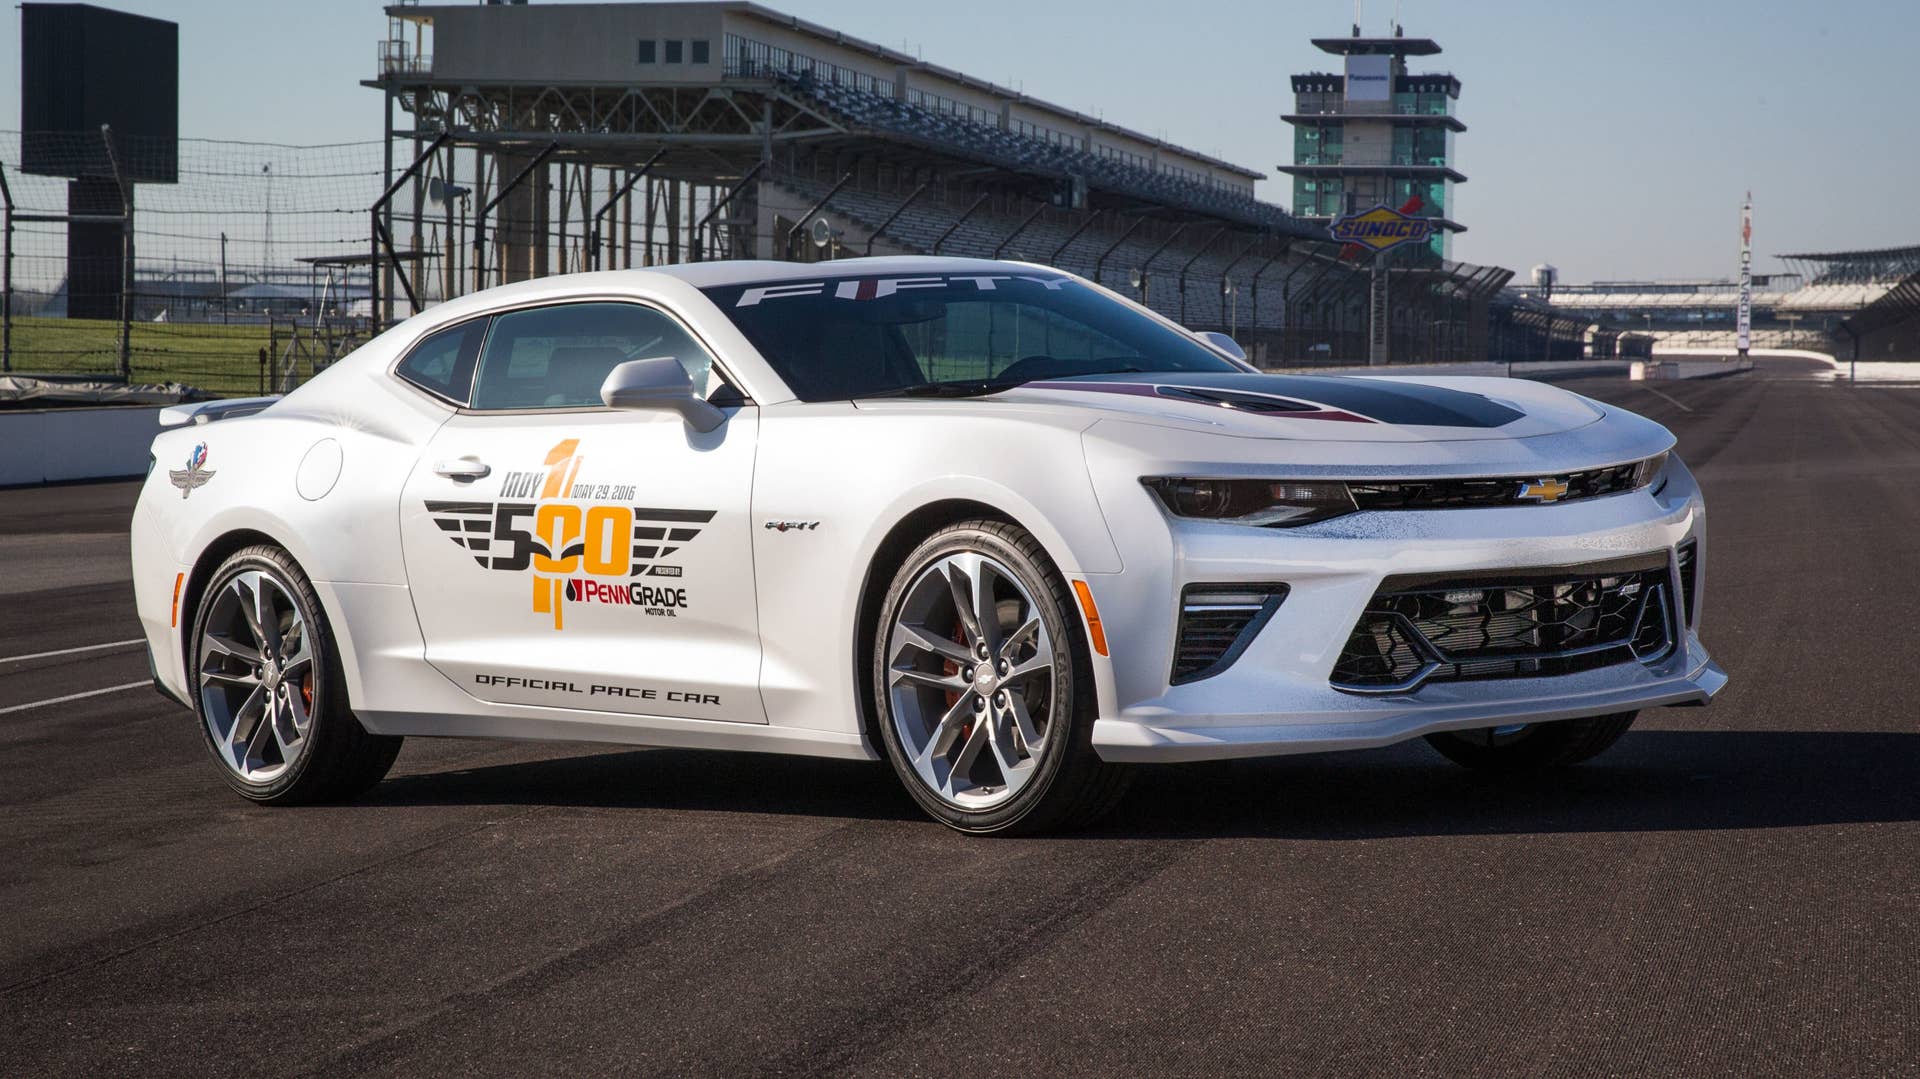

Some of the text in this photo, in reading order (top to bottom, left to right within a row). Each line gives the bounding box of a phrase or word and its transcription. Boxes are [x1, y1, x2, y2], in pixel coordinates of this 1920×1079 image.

[1305, 84, 1312, 92] 2
[1317, 84, 1323, 92] 3
[1327, 84, 1334, 92] 4
[1419, 84, 1425, 92] 6
[1430, 84, 1436, 92] 7
[1339, 221, 1425, 237] SUNOCO
[736, 276, 1076, 307] FIFTY
[1739, 251, 1750, 341] CHEVROLET
[499, 472, 543, 498] INDY
[571, 484, 595, 499] MAY
[611, 485, 637, 500] 2016
[492, 502, 632, 576] 500
[645, 607, 677, 617] MOTOR OIL
[475, 674, 721, 706] OFFICIAL PACE CAR
